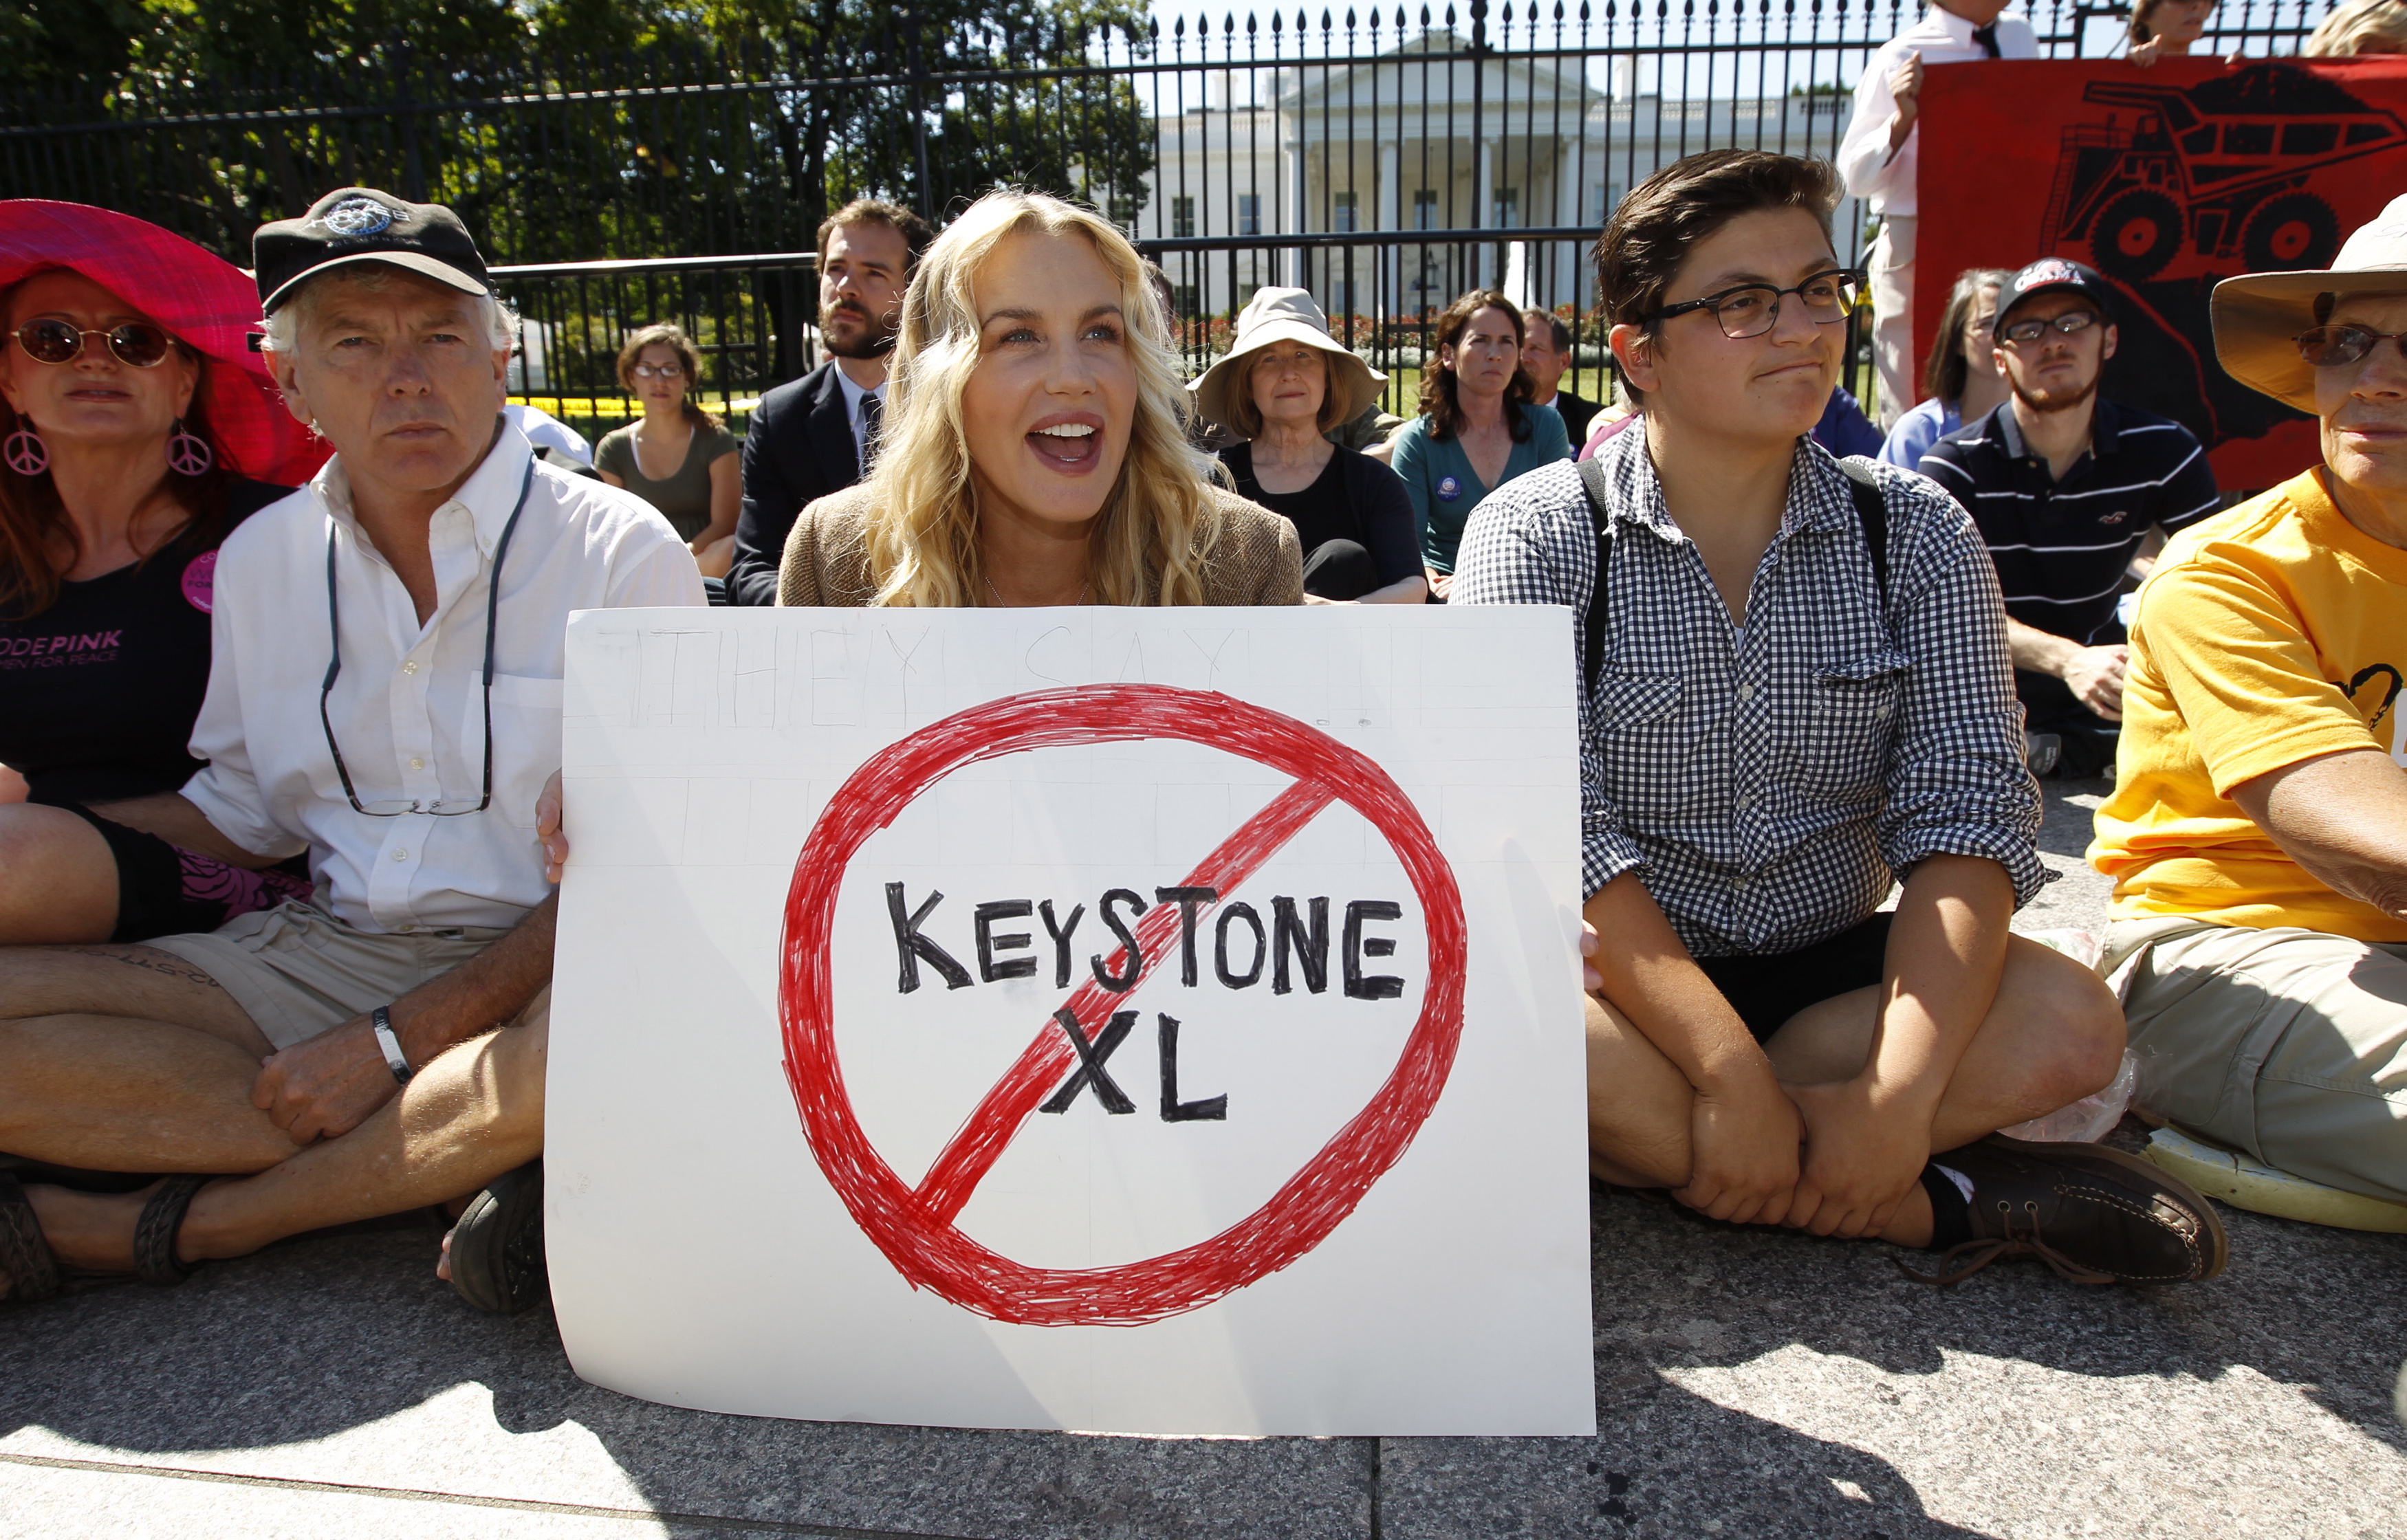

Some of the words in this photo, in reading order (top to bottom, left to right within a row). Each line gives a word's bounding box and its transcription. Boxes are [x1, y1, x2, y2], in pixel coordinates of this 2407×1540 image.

[32, 655, 65, 668] FOR
[68, 650, 118, 666] PEACE
[885, 881, 1406, 1000] KEYSTONE
[1038, 1006, 1229, 1123] XL
